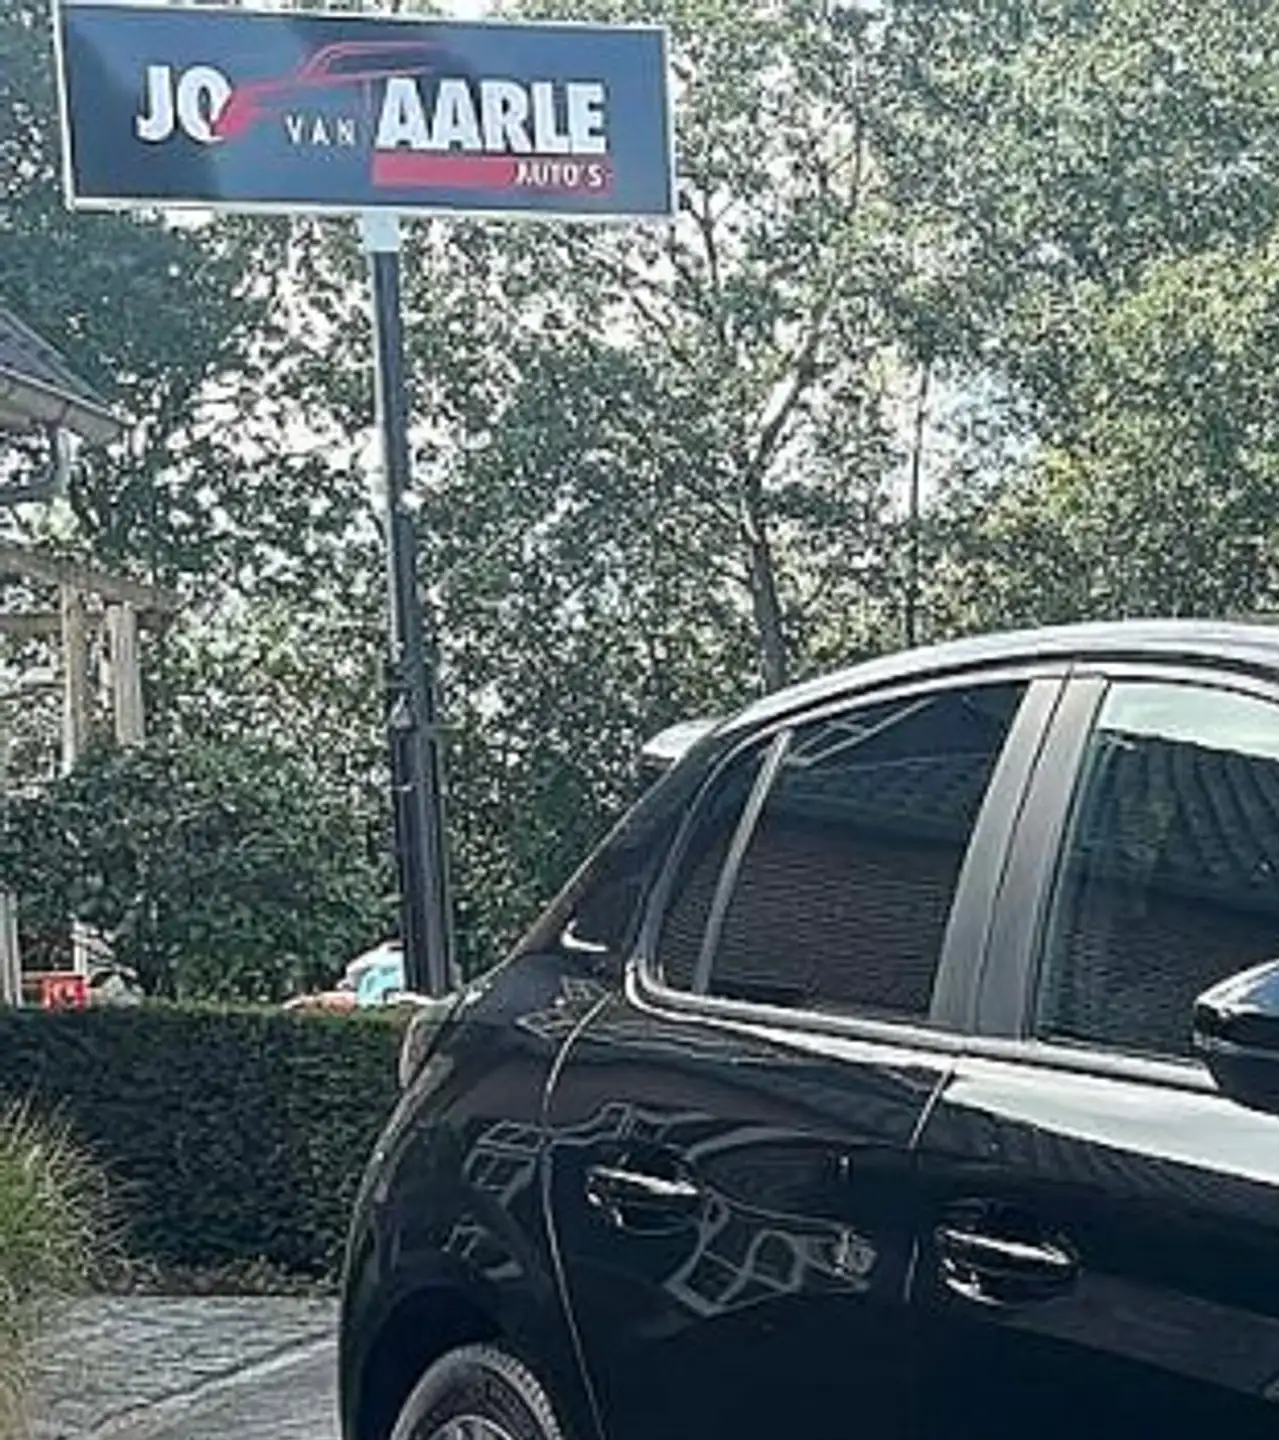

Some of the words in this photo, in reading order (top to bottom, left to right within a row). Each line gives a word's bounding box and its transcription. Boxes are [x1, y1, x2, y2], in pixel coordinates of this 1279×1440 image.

[286, 115, 356, 145] VAN
[374, 77, 608, 154] AARLE
[514, 163, 602, 188] AUTO'S
